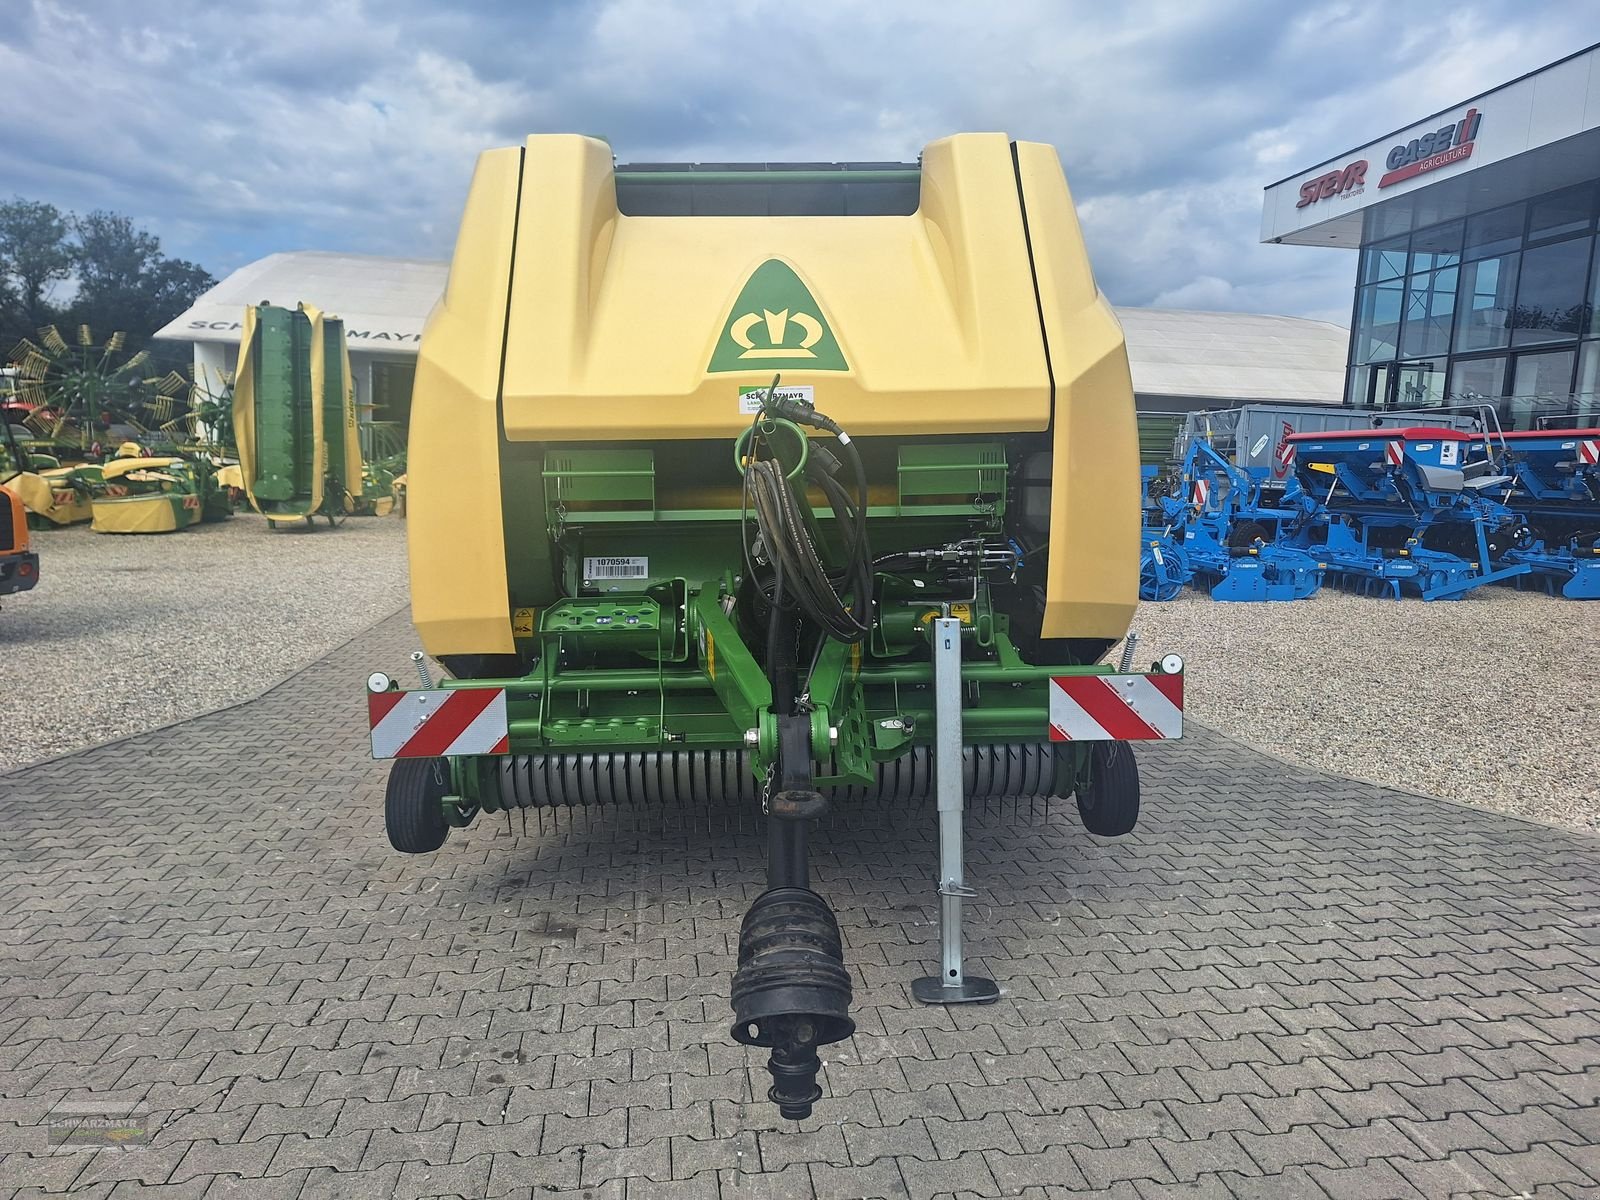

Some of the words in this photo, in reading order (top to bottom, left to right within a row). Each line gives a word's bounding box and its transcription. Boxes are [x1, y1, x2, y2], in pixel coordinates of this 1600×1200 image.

[1386, 123, 1456, 171] CASE
[1419, 146, 1468, 171] AGRICULTURE
[1296, 159, 1369, 208] STEYR
[597, 558, 630, 566] 1070594
